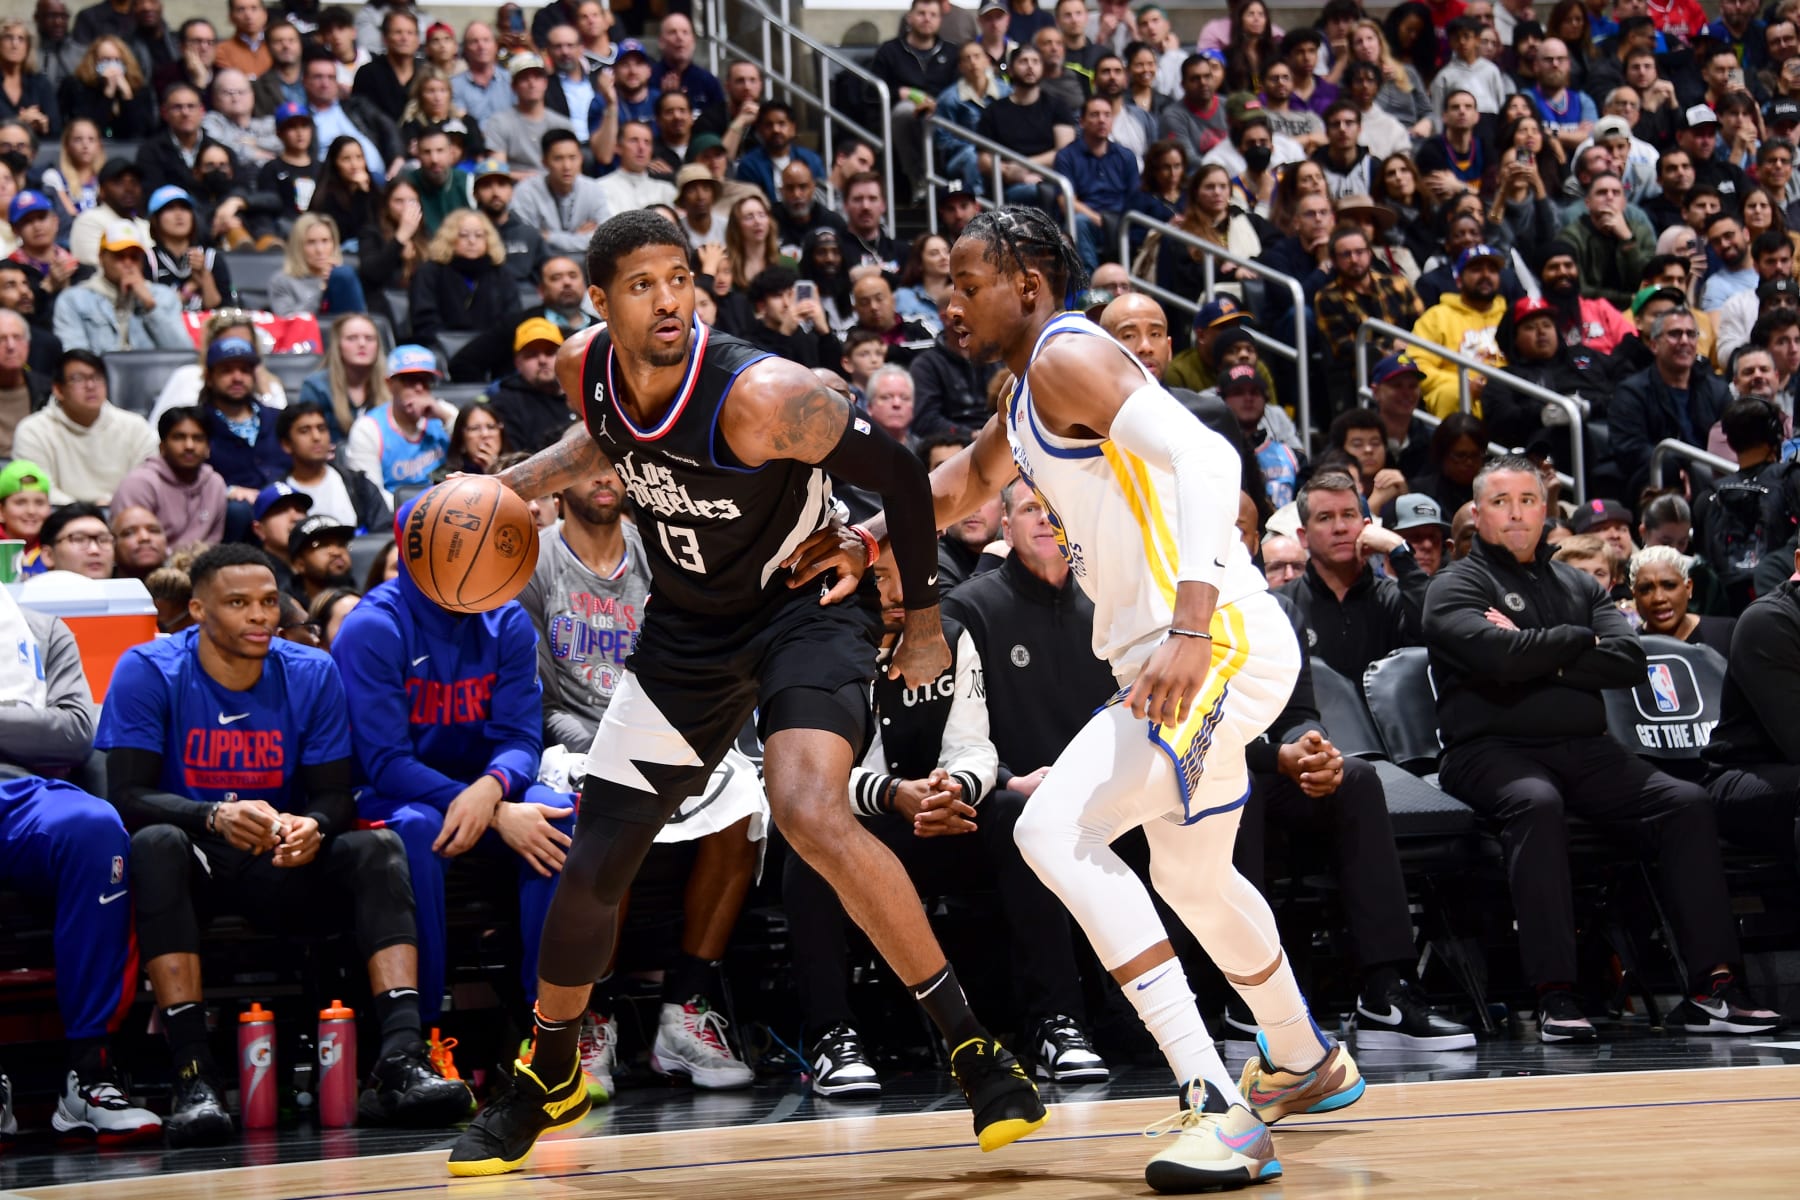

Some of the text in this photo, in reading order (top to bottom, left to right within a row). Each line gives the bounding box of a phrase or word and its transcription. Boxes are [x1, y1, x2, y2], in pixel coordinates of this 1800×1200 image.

[594, 382, 604, 402] 6
[615, 451, 677, 493] Los
[657, 520, 707, 574] 13
[592, 614, 614, 629] LOS
[183, 727, 284, 769] CLIPPERS
[1636, 723, 1662, 749] GET
[1660, 723, 1693, 749] THE
